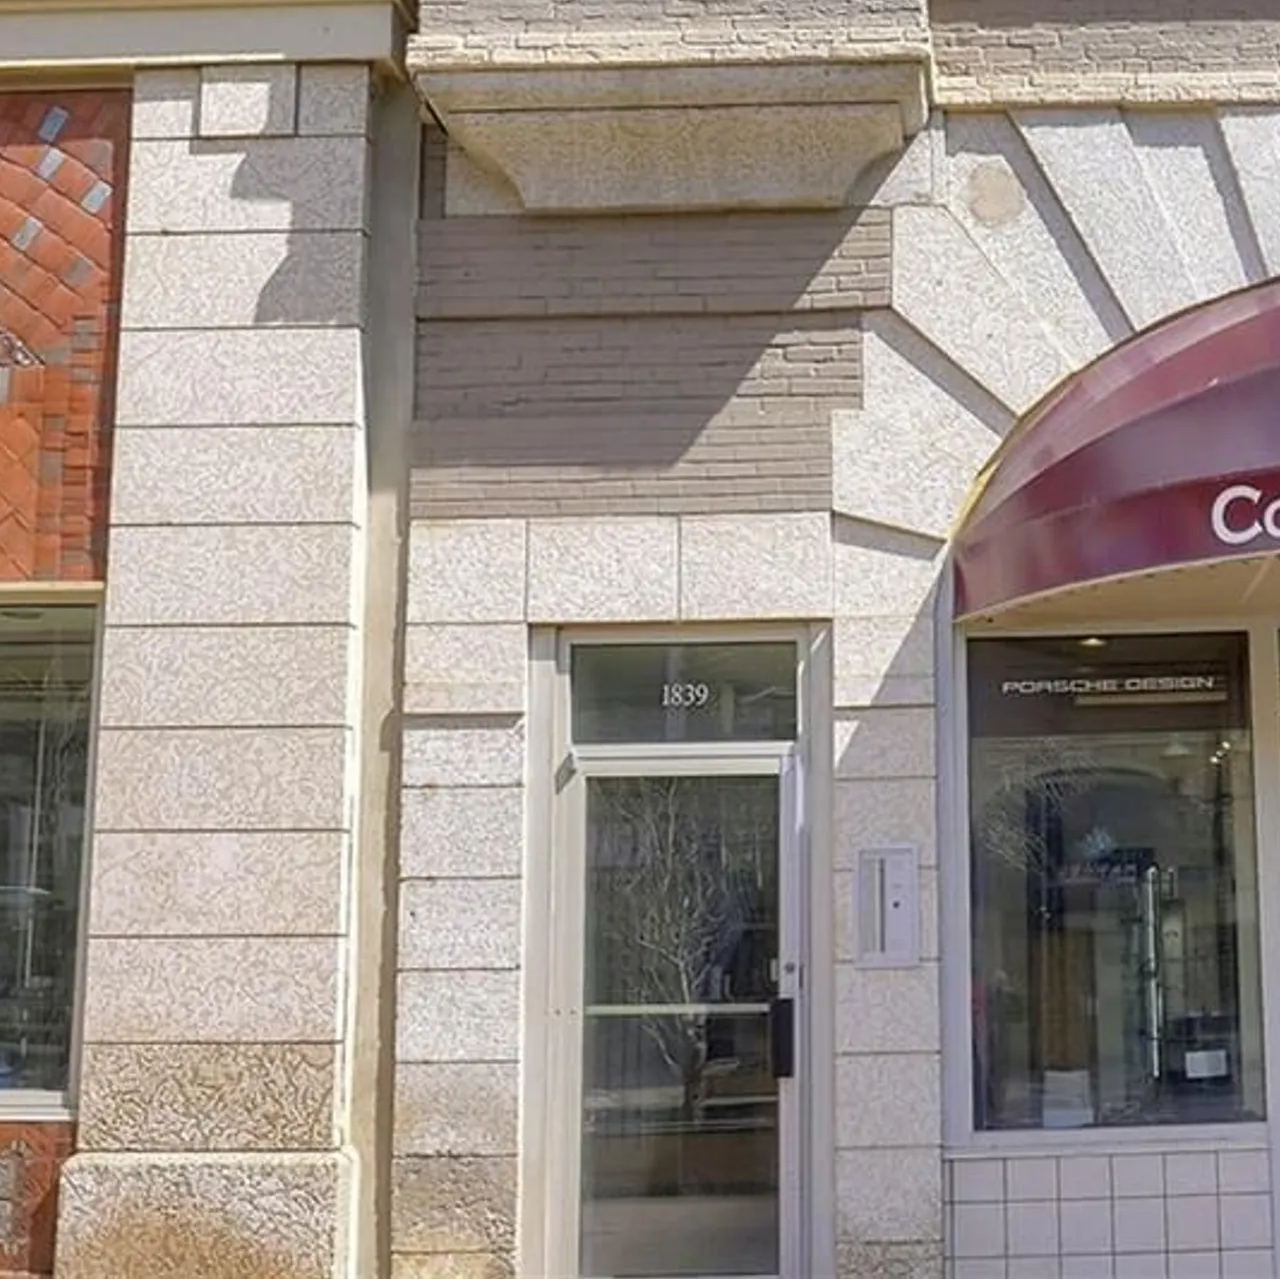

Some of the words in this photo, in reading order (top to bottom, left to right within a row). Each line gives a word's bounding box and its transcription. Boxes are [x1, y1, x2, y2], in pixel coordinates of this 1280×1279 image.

[661, 683, 709, 707] 1839
[1001, 678, 1118, 694] PORSCHE
[1124, 676, 1214, 692] DESIGN
